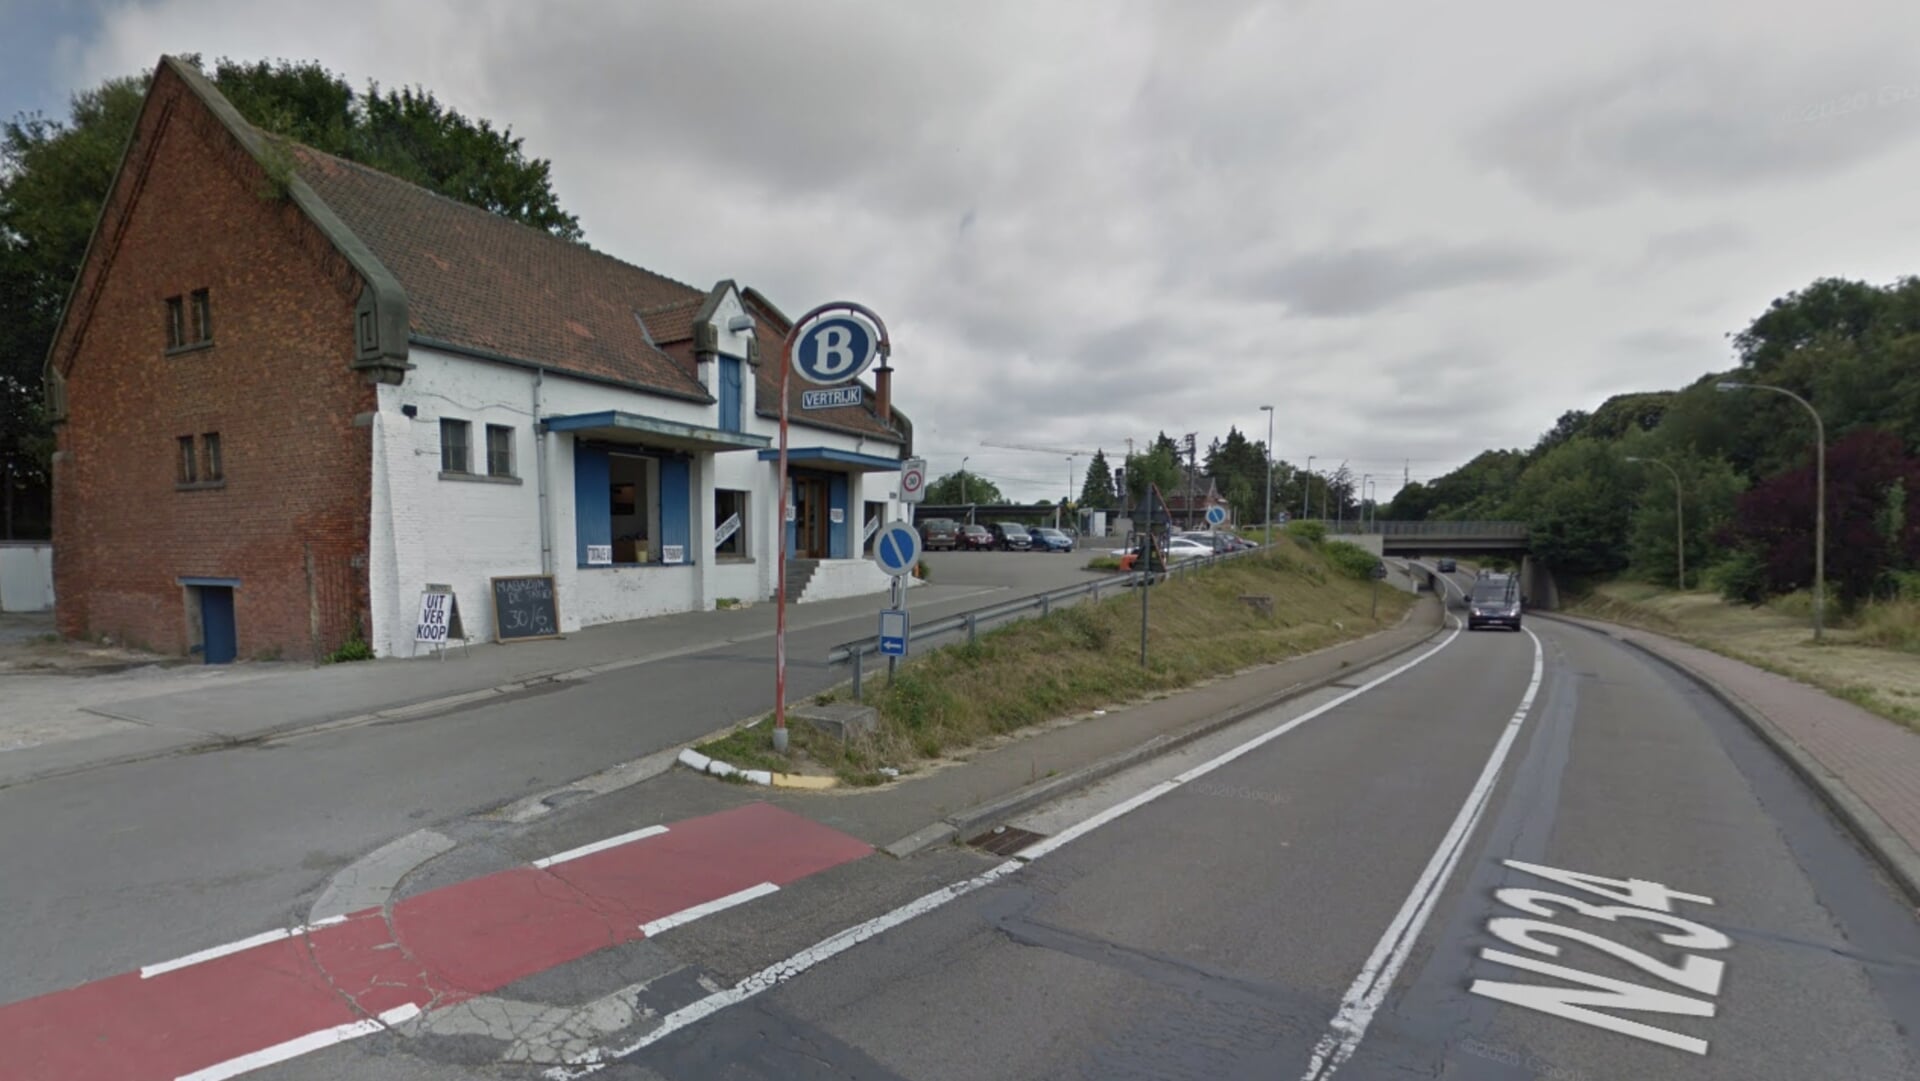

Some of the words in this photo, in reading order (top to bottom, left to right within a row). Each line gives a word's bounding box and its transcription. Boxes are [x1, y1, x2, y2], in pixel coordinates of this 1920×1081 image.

[813, 325, 854, 375] B
[804, 388, 859, 406] VERTRIJK
[427, 594, 445, 609] UIT
[423, 609, 444, 624] VER
[416, 624, 446, 640] KOOP
